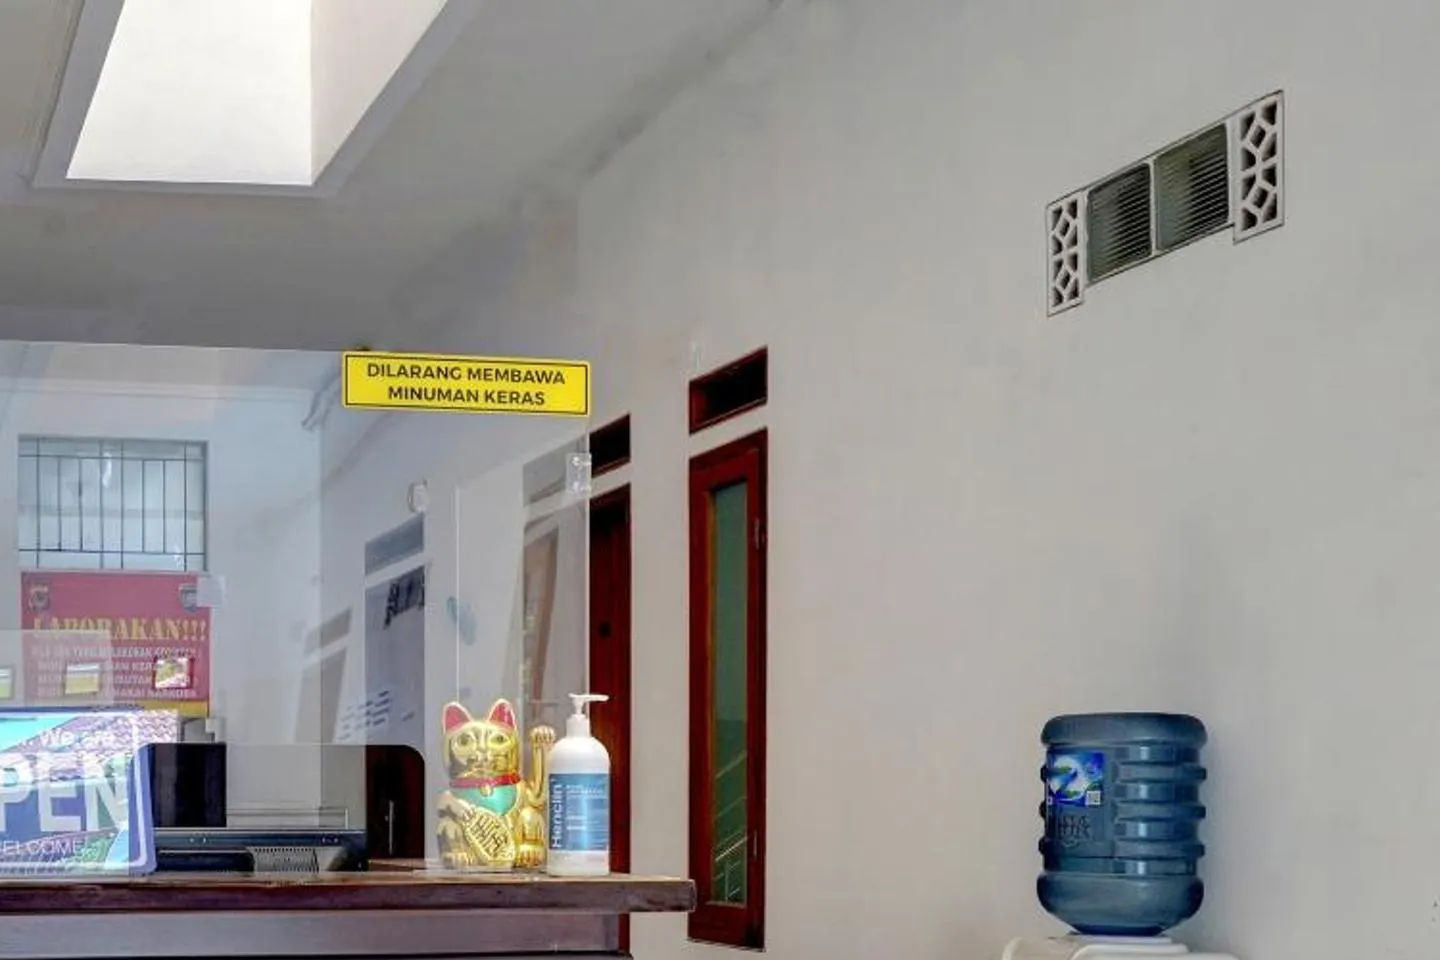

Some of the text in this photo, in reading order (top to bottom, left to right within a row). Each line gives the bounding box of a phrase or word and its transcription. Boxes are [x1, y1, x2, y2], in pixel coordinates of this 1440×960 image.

[367, 362, 566, 385] DILARANG MEMBAWA
[387, 386, 546, 406] MINUMAN KERAS
